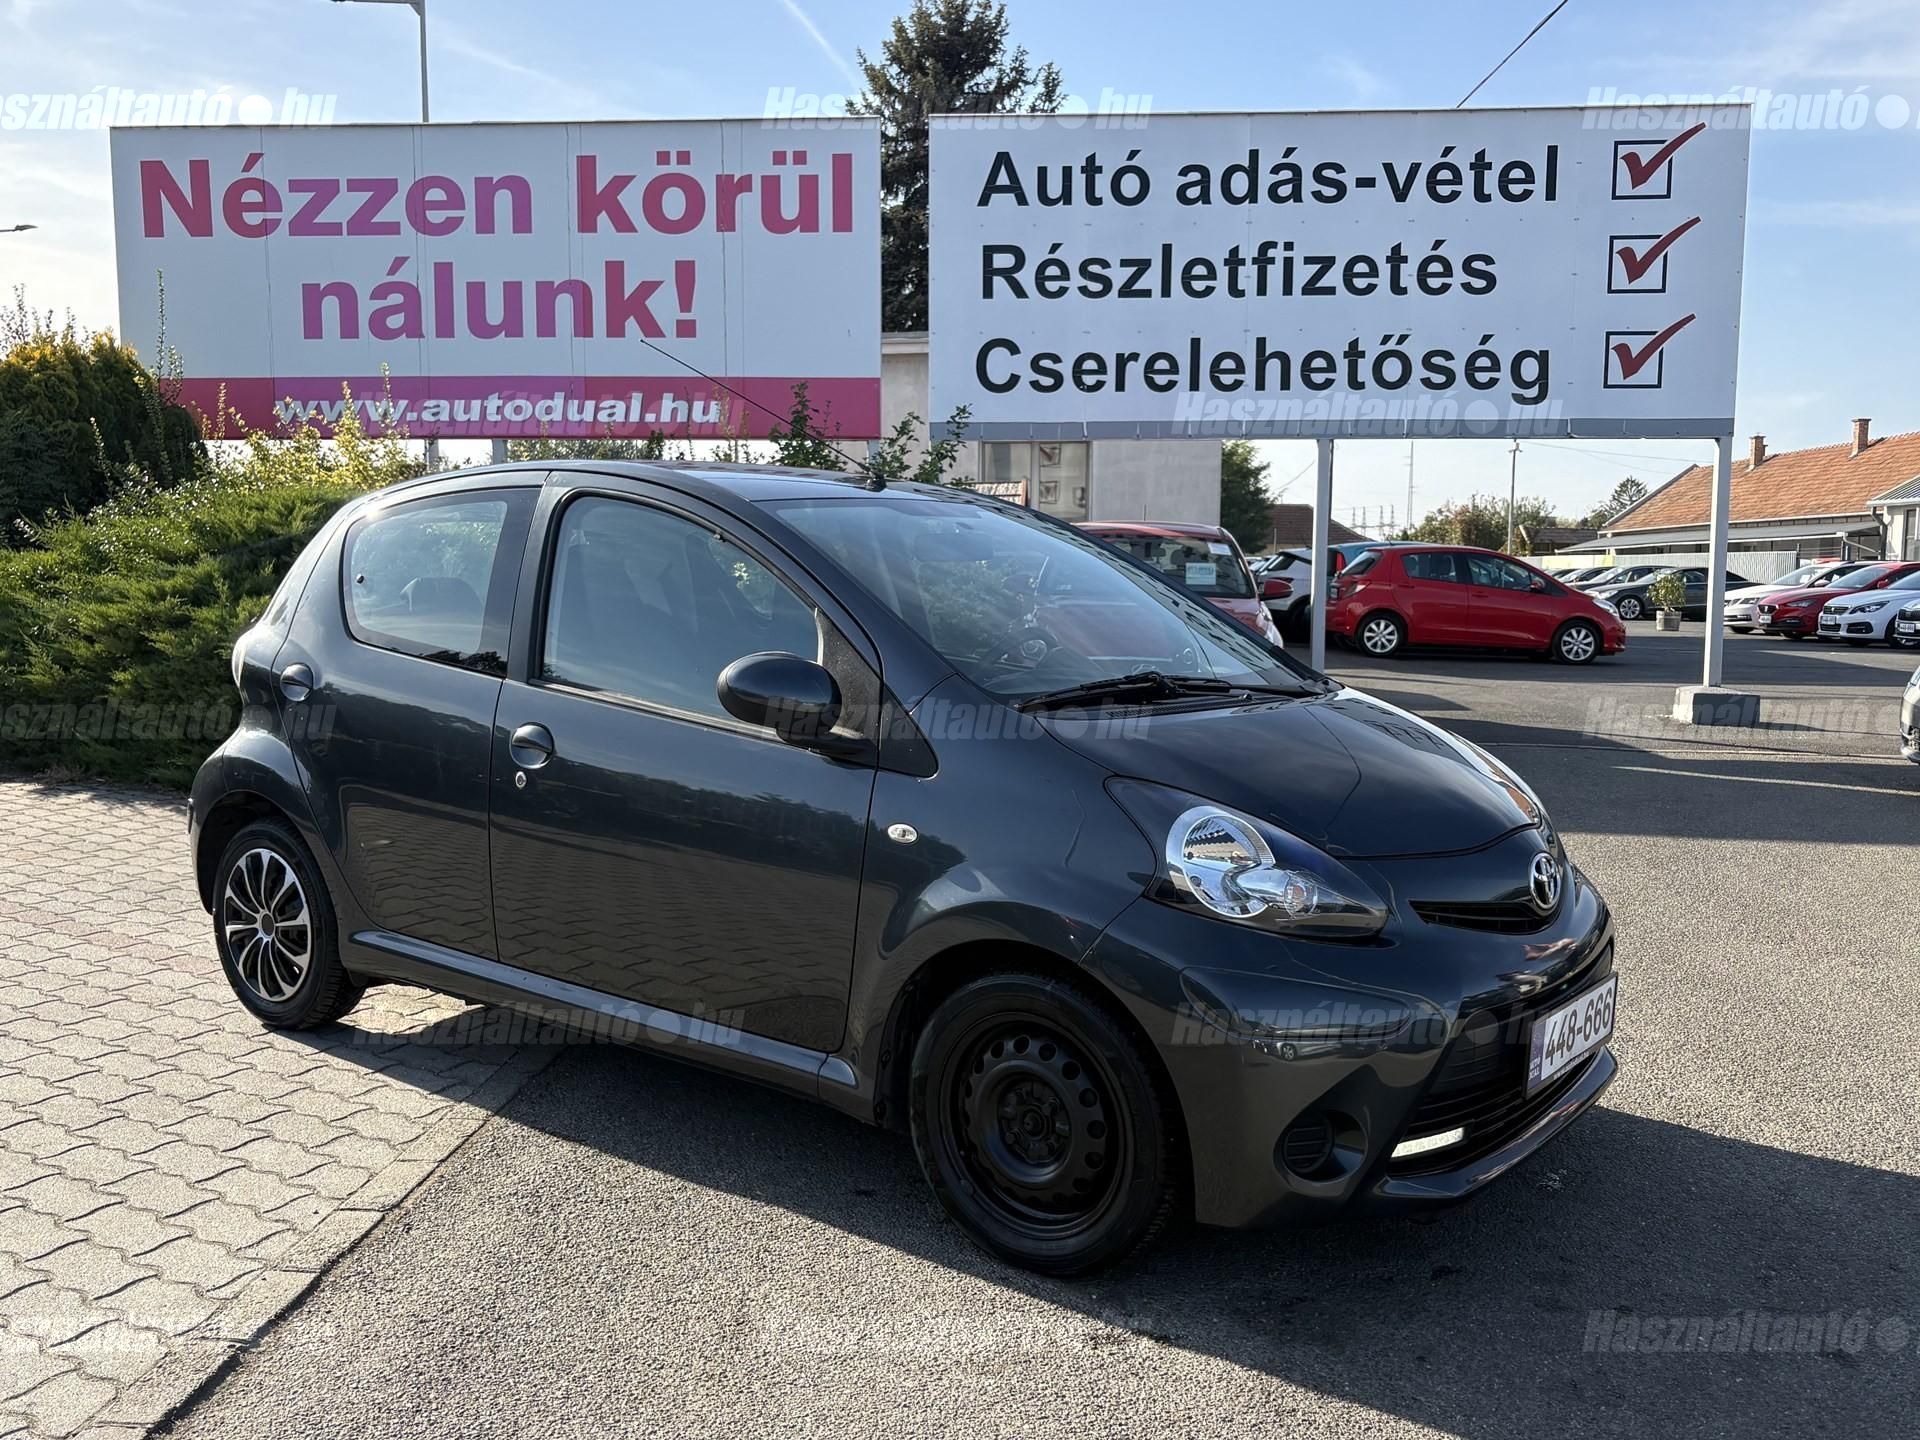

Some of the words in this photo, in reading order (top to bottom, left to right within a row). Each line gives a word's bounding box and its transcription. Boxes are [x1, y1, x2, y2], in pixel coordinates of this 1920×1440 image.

[139, 152, 533, 239] Nézzen
[576, 149, 854, 235] körül
[977, 149, 1151, 207] Autó
[1176, 144, 1559, 206] adás-vétel
[301, 256, 697, 341] nálunk!
[981, 239, 1498, 300] Részletfizetés
[975, 334, 1551, 406] Cserelehetőség
[274, 391, 722, 424] www.autodual.hu
[1544, 987, 1613, 1066] 448-666
